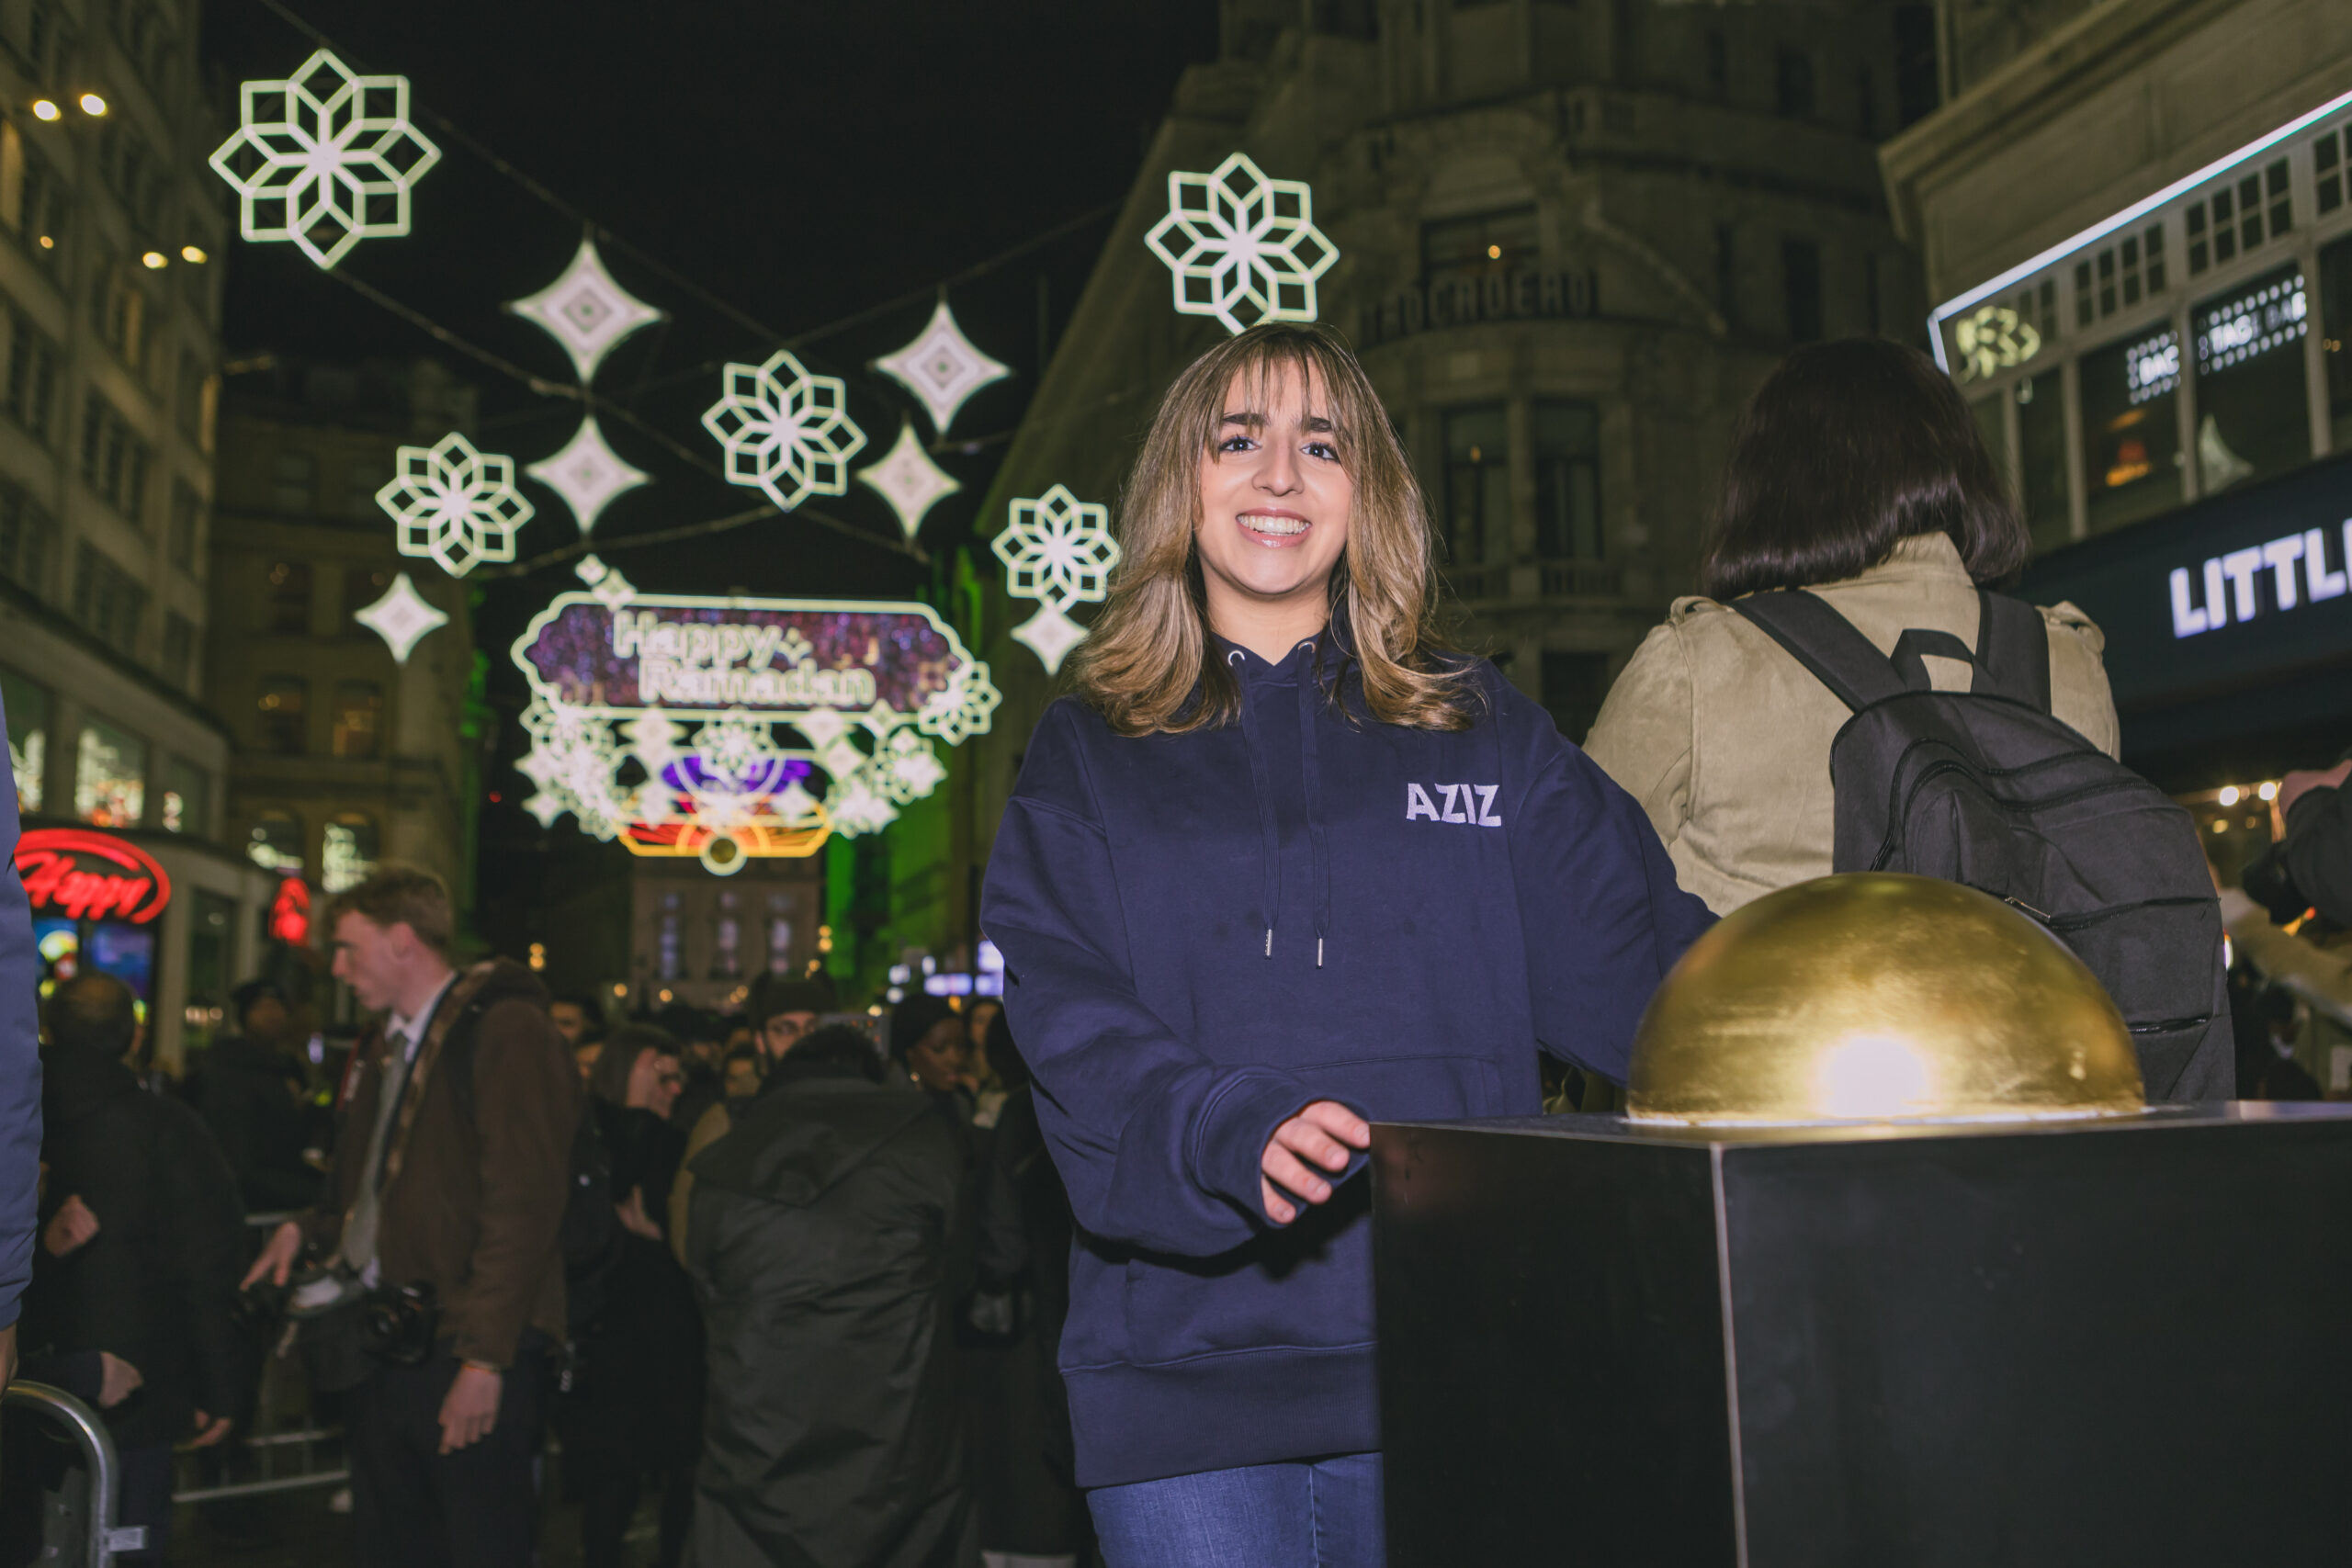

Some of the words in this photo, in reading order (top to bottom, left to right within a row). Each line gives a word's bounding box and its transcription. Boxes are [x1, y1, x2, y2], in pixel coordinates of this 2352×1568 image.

[613, 610, 784, 670] Happy
[639, 657, 877, 705] Ramadan
[1406, 783, 1502, 828] AZIZ
